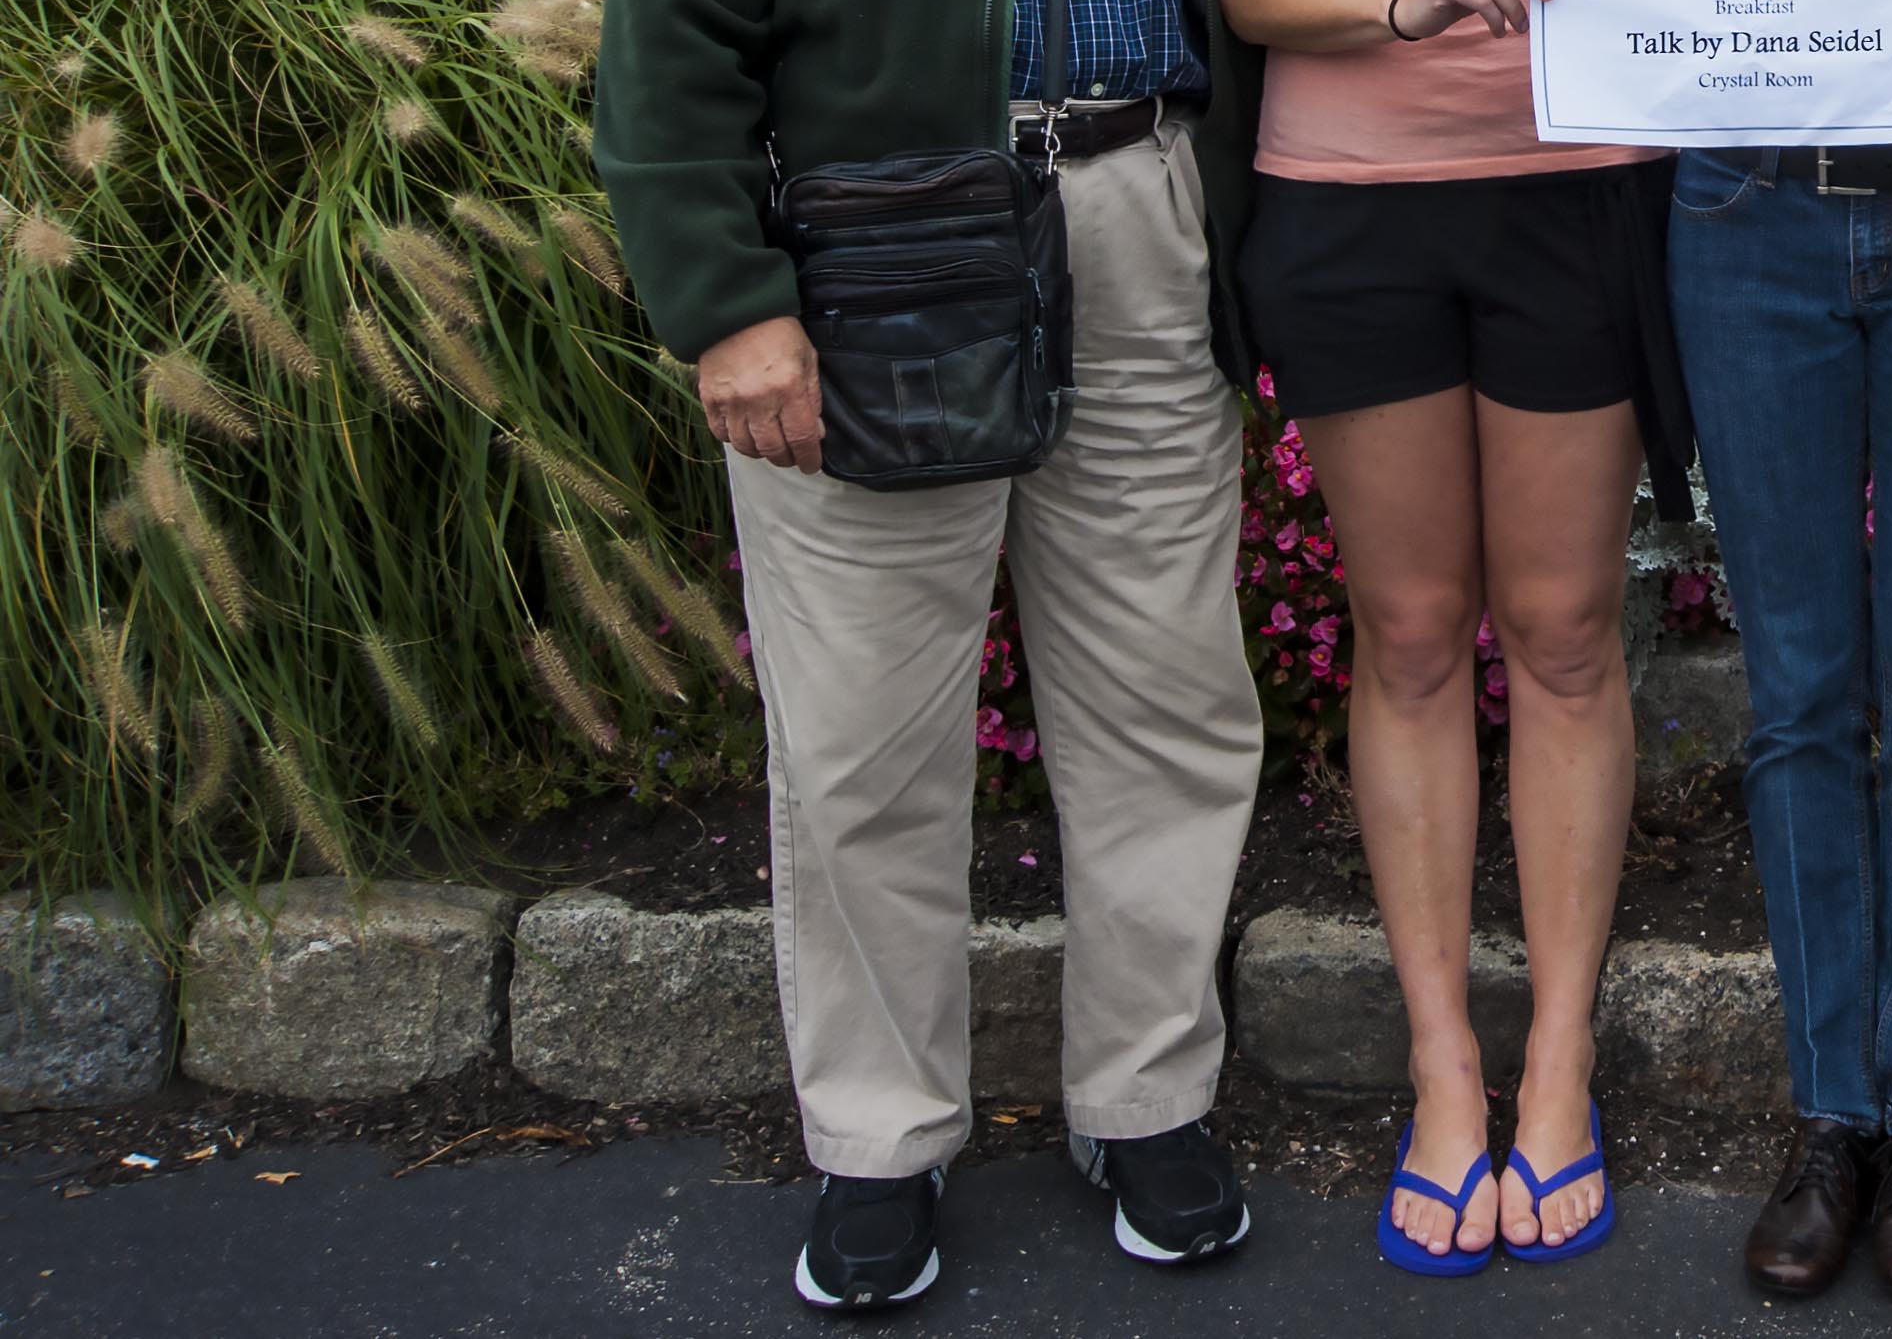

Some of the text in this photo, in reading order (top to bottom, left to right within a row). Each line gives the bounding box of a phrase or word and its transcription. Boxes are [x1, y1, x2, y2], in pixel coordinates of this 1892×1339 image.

[1627, 29, 1883, 59] Talk by Dana Seidel
[1698, 71, 1814, 92] Crystal Room
